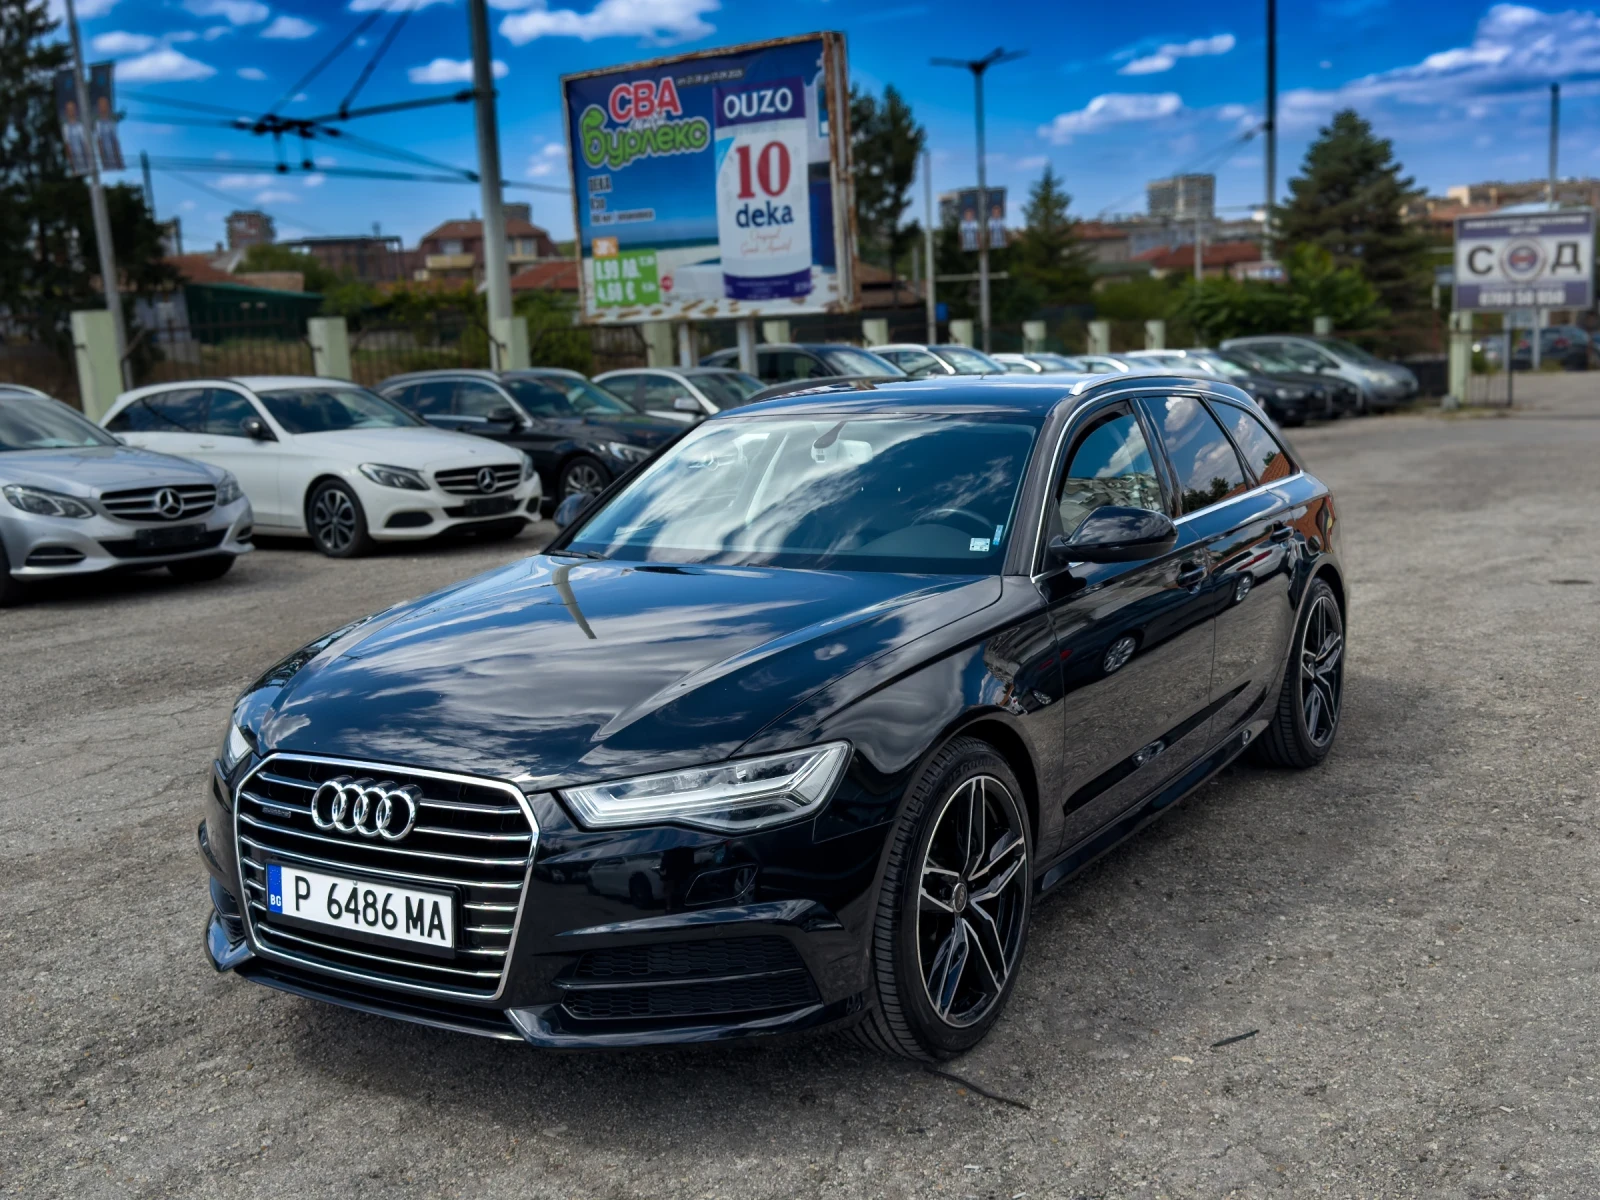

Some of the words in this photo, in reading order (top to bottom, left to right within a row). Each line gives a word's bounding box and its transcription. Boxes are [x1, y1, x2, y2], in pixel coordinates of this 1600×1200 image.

[723, 87, 793, 119] OUZO
[735, 140, 791, 199] 10
[735, 200, 794, 228] deka
[270, 893, 282, 907] BG
[294, 875, 311, 912] P
[326, 882, 398, 930] 6486
[405, 895, 446, 941] MA
